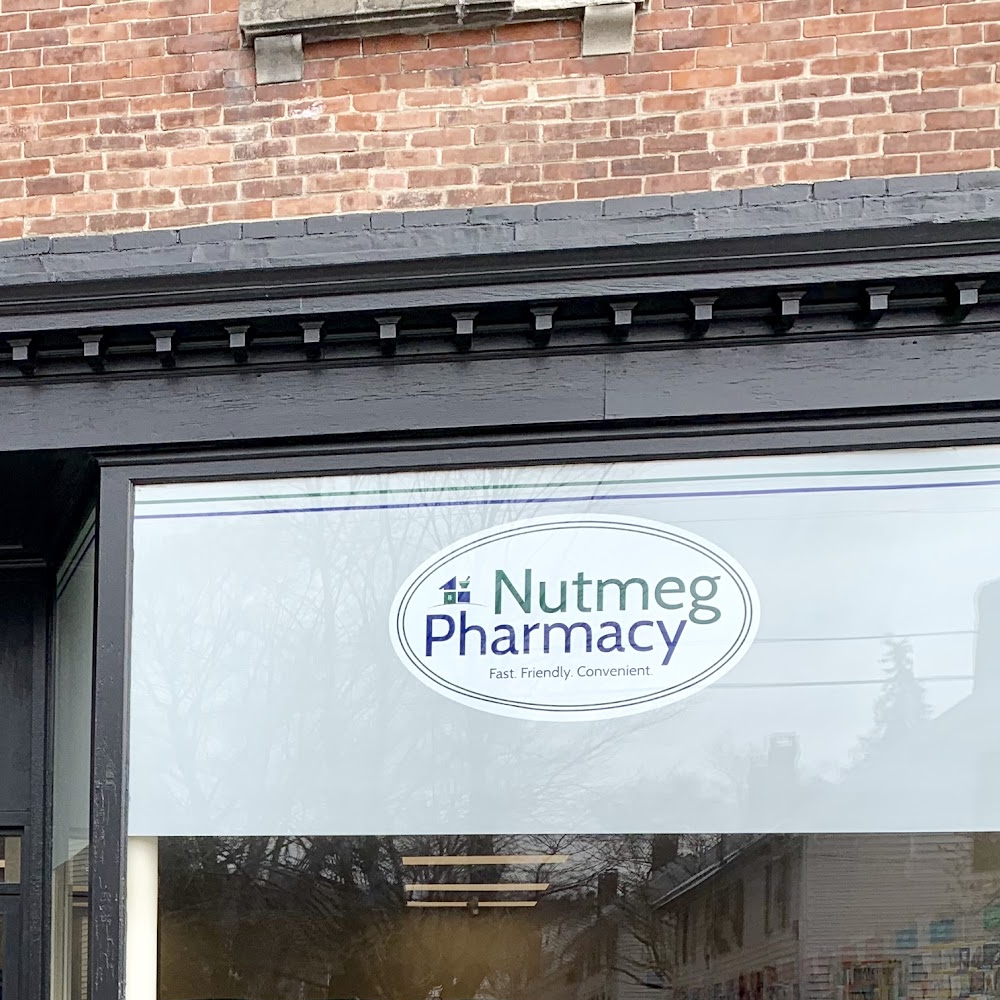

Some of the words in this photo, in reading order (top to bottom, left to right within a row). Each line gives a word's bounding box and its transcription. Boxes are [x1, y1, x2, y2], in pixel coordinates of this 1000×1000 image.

[494, 568, 721, 625] Nutmeg
[425, 610, 687, 666] Pharmacy
[489, 667, 517, 680] Fast.
[520, 667, 574, 682] Friendly.
[576, 665, 653, 679] Convenient.
